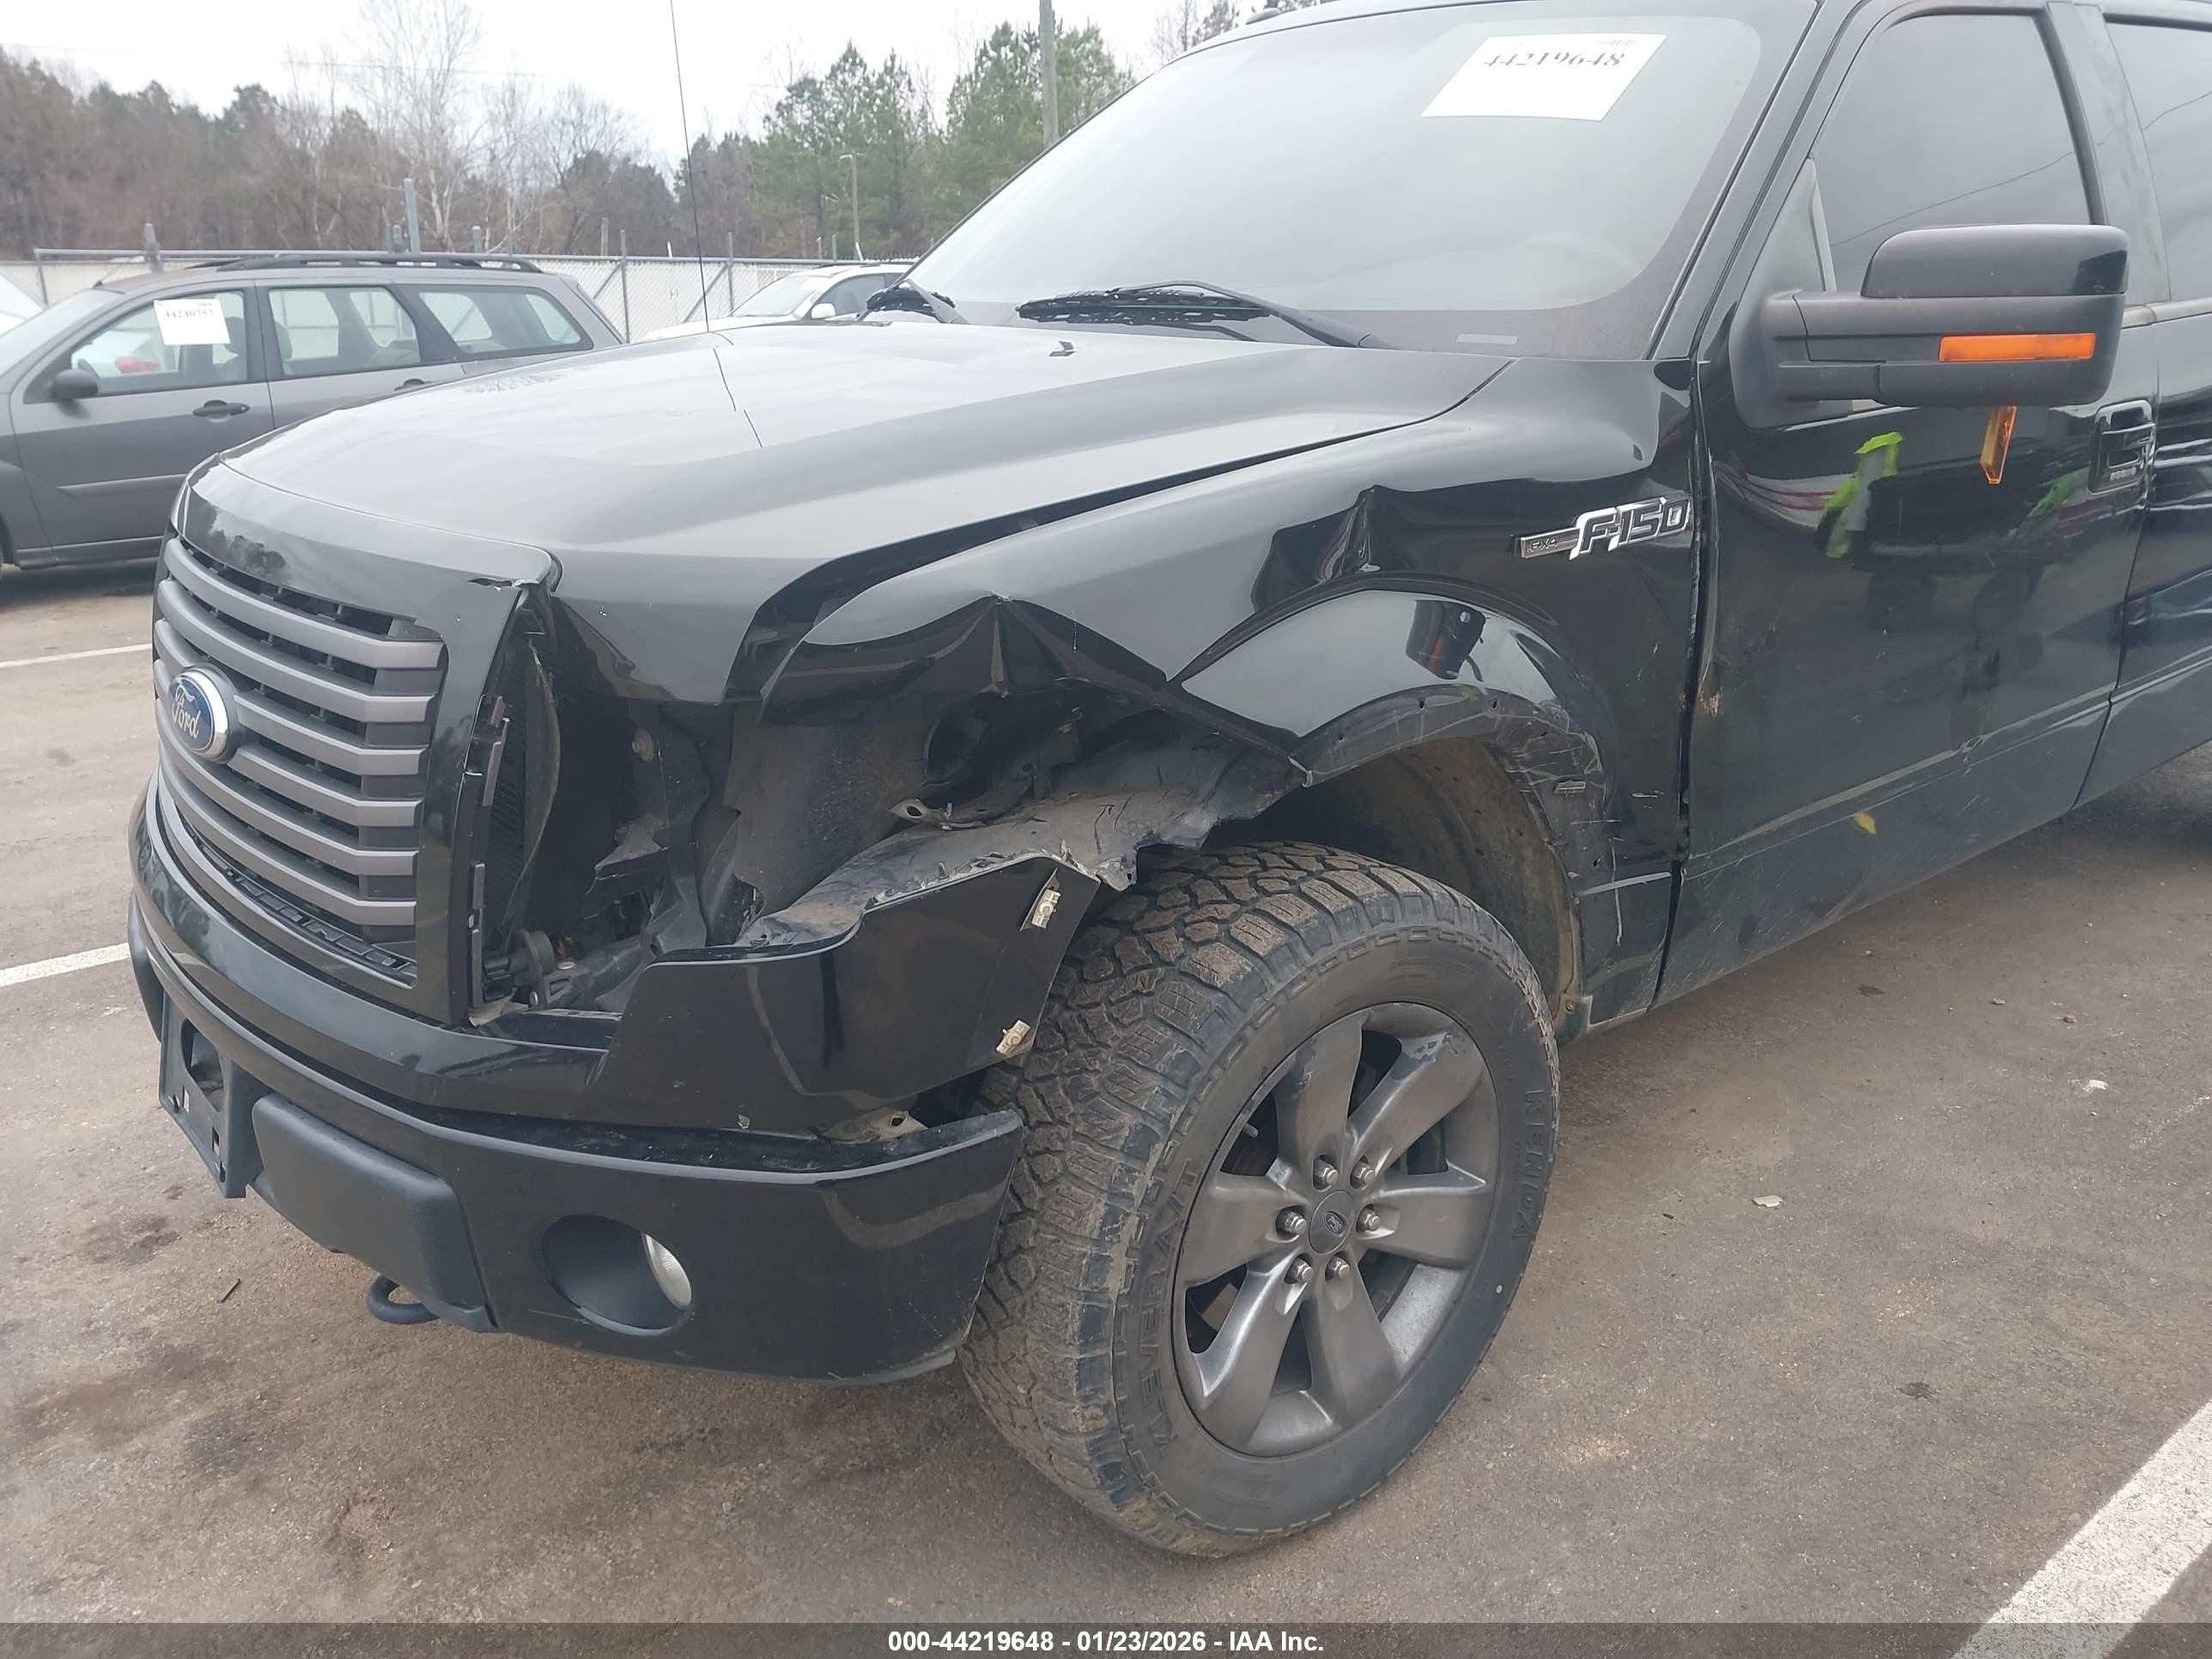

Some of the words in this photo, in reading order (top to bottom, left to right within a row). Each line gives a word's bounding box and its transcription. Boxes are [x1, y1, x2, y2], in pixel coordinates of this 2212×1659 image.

[1482, 51, 1626, 68] 44219648
[171, 684, 203, 740] Ford
[1510, 1089, 1547, 1239] KENDA
